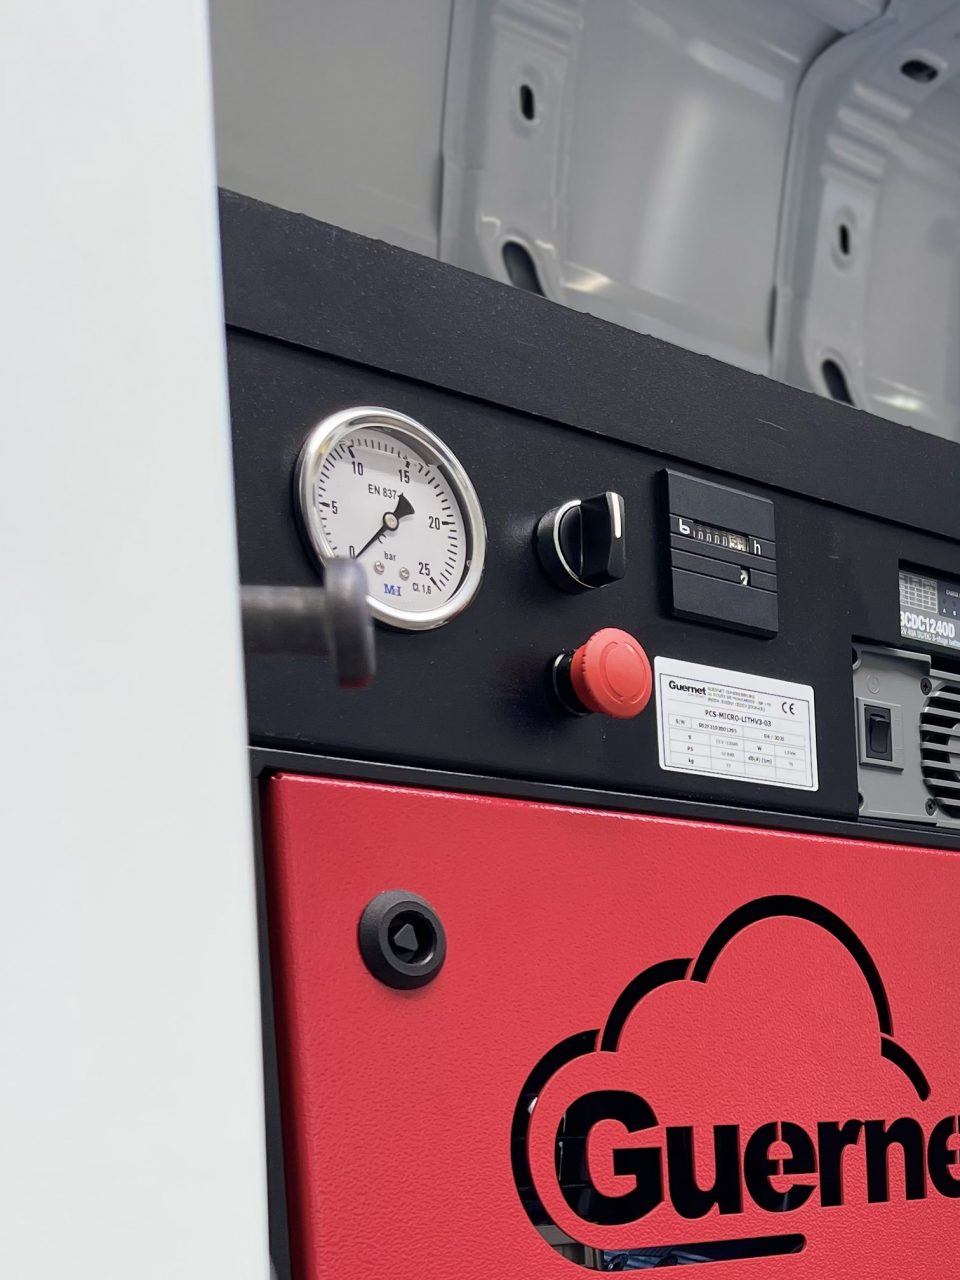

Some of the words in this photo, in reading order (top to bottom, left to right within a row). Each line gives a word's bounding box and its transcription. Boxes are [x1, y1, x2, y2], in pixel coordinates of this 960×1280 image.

[352, 461, 364, 476] 10
[398, 469, 410, 484] 15
[368, 483, 380, 495] EN
[383, 487, 403, 500] 837-
[332, 500, 338, 515] 5
[429, 516, 440, 530] 20
[349, 545, 355, 559] 0
[384, 550, 396, 560] bar
[754, 540, 761, 555] h
[419, 562, 431, 576] 25
[669, 680, 706, 696] Guernet
[705, 709, 772, 727] PCS-MICRO-LITHV3-03
